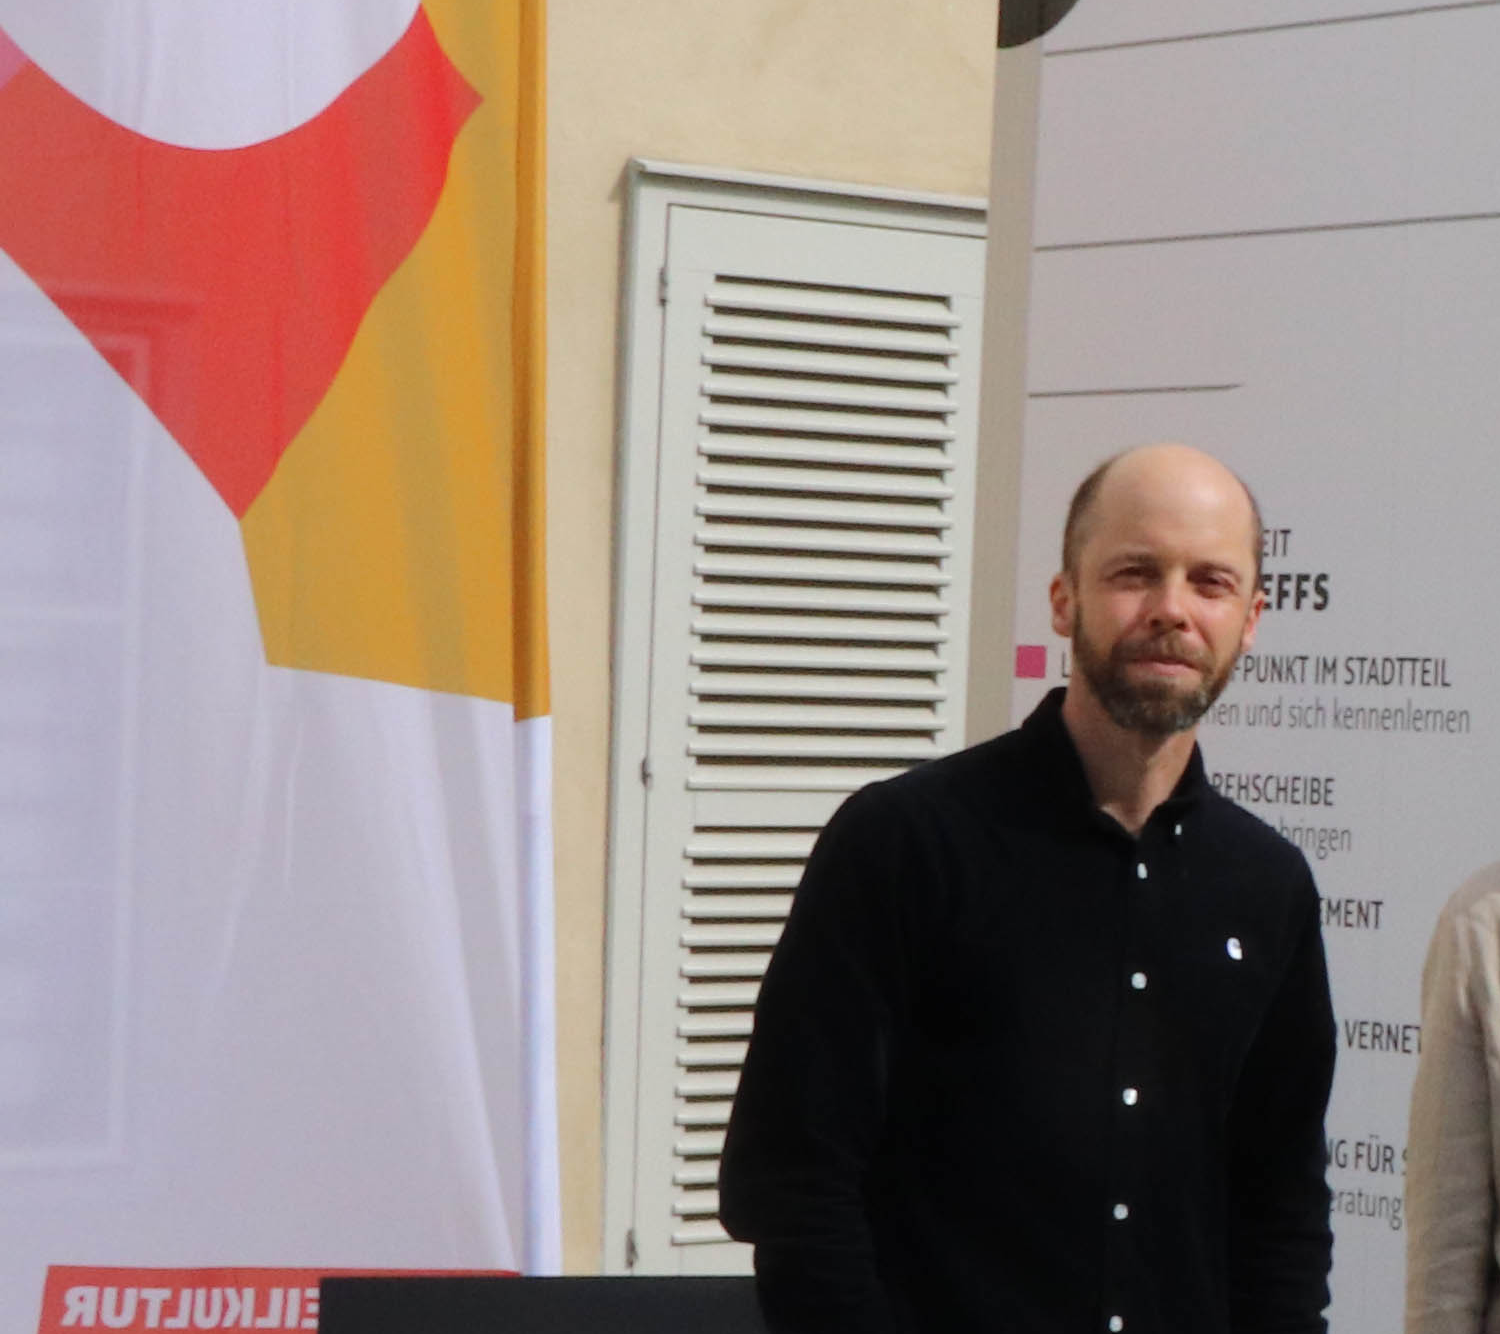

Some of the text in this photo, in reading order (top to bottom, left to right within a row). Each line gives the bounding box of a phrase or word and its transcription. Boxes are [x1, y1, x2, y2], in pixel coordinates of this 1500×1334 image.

[1231, 655, 1452, 687] PUNKT IM STADTTEIL
[1246, 696, 1283, 728] und
[1288, 696, 1327, 730] sich
[1333, 697, 1471, 734] kennenlernen
[1354, 1134, 1395, 1175] FÜR
